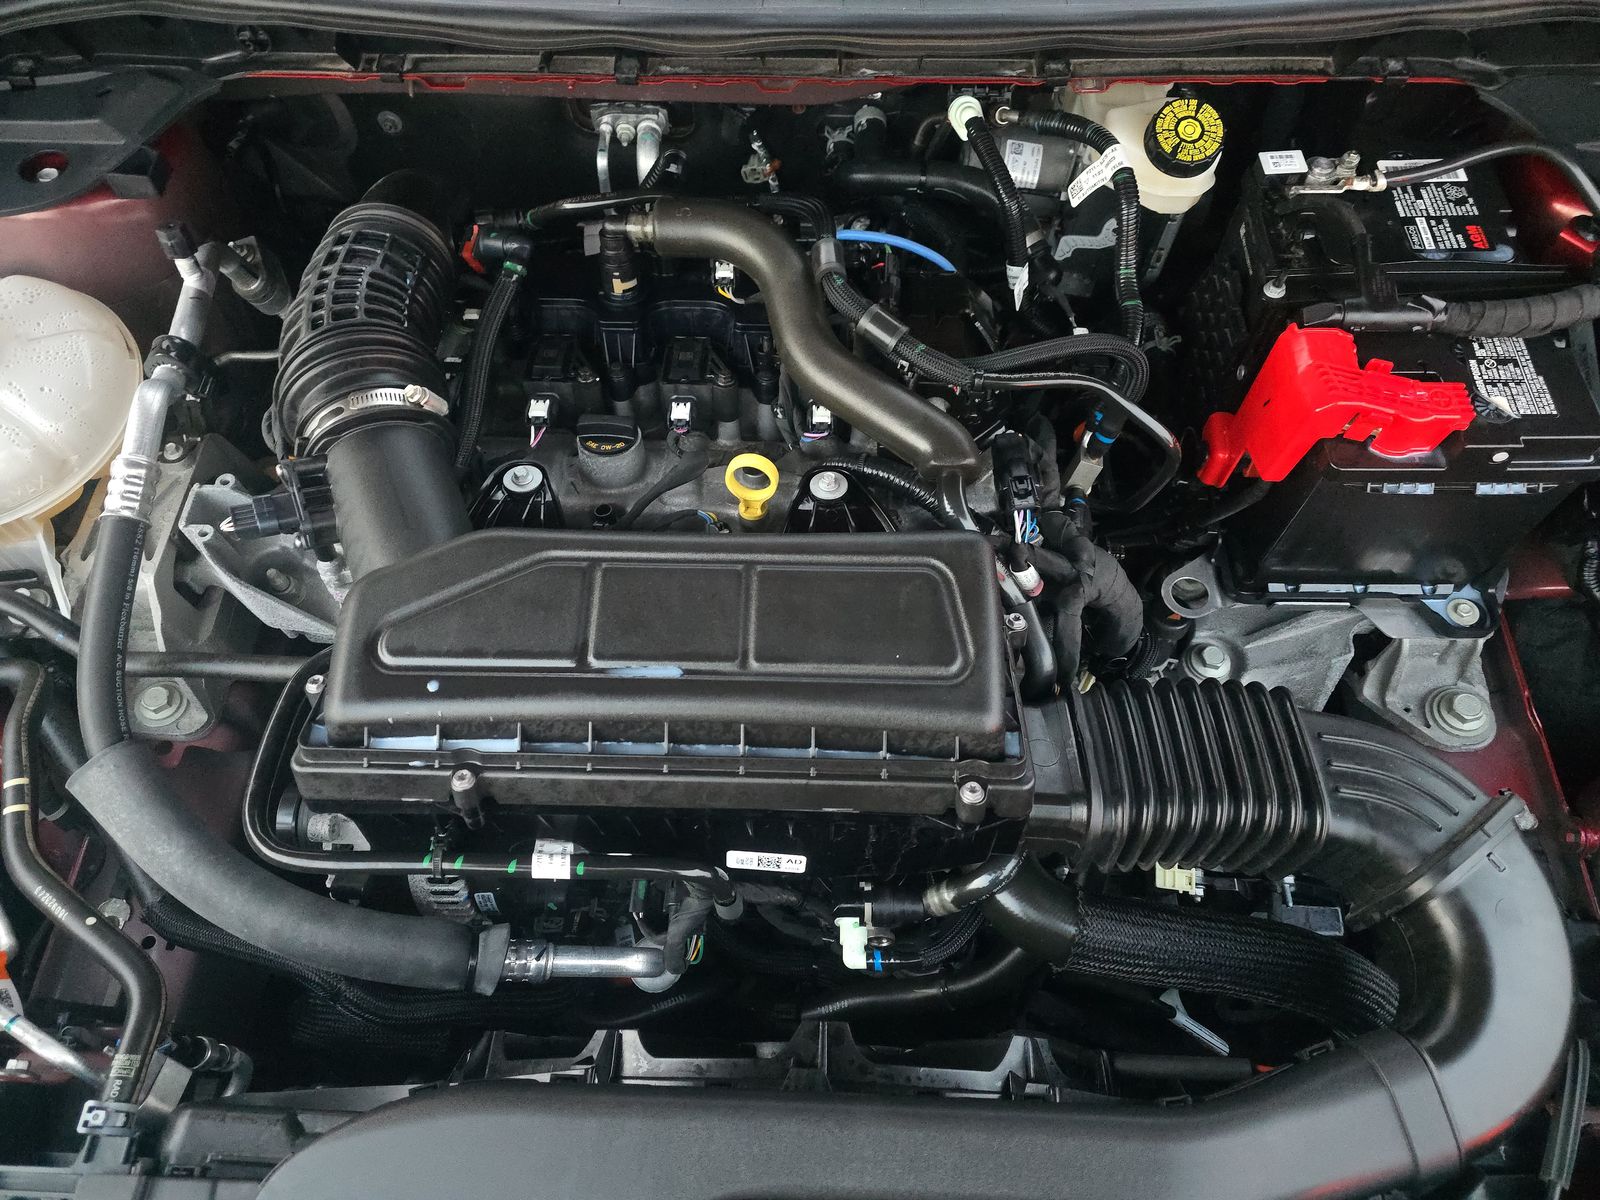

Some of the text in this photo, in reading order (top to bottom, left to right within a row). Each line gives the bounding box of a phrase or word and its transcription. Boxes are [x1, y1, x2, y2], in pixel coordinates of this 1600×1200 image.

[1465, 225, 1485, 249] AGM
[586, 440, 625, 450] SAE 0W-20
[115, 669, 124, 708] SUCTION
[118, 709, 128, 732] HOSE
[110, 1079, 123, 1098] RAD
